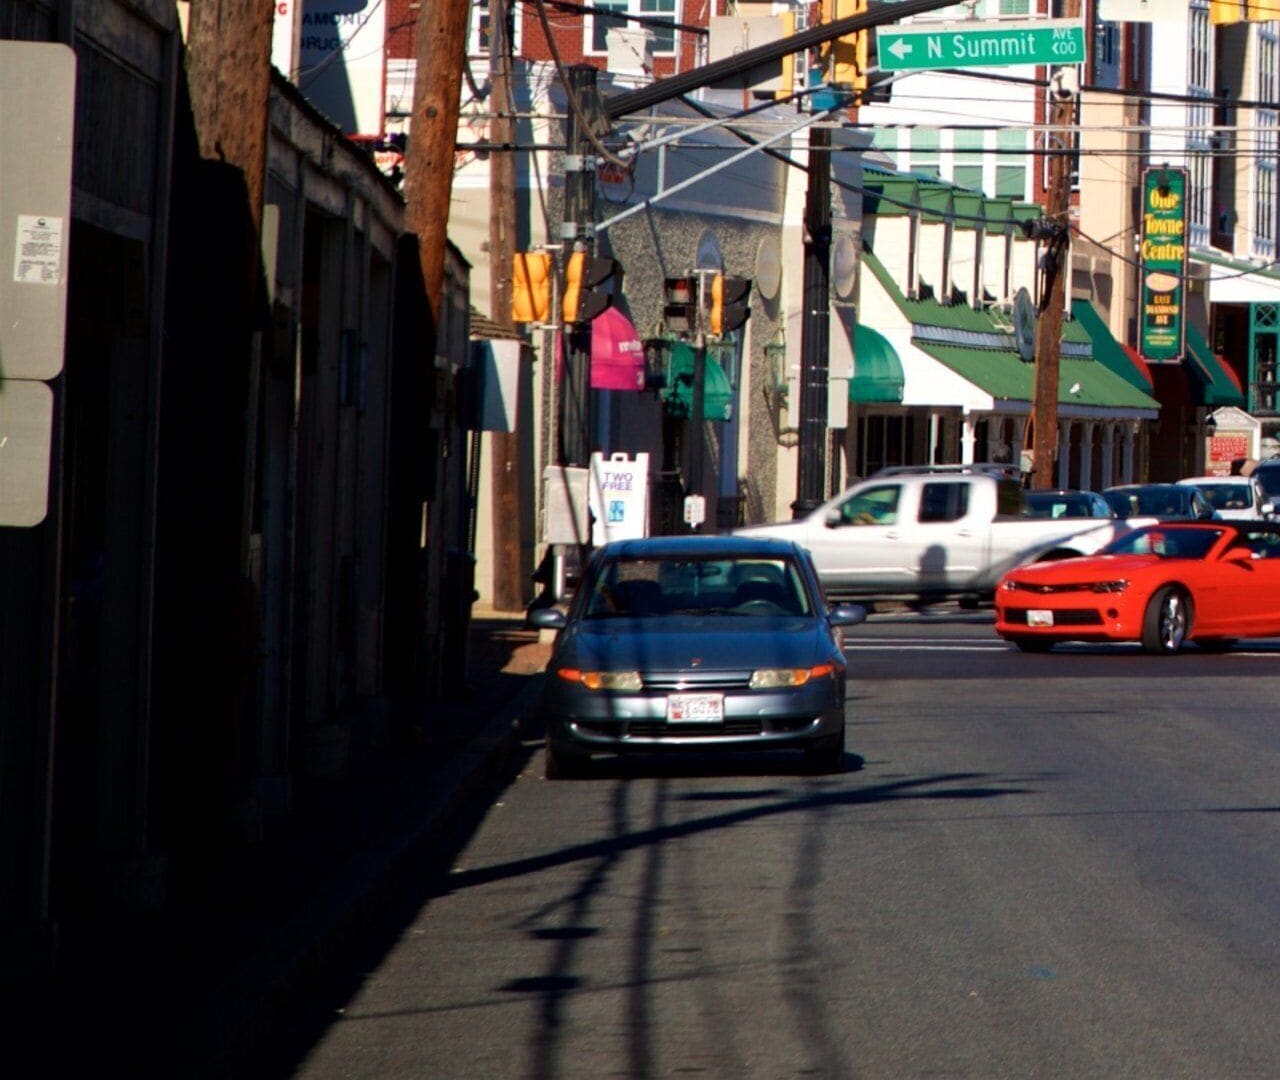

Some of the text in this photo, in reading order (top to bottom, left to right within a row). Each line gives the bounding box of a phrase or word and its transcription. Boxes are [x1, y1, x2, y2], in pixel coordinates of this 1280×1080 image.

[927, 32, 1036, 59] N Summit
[1052, 29, 1074, 40] AVE
[1144, 213, 1184, 235] Towne
[1142, 239, 1185, 261] Centre
[604, 472, 634, 482] TWO
